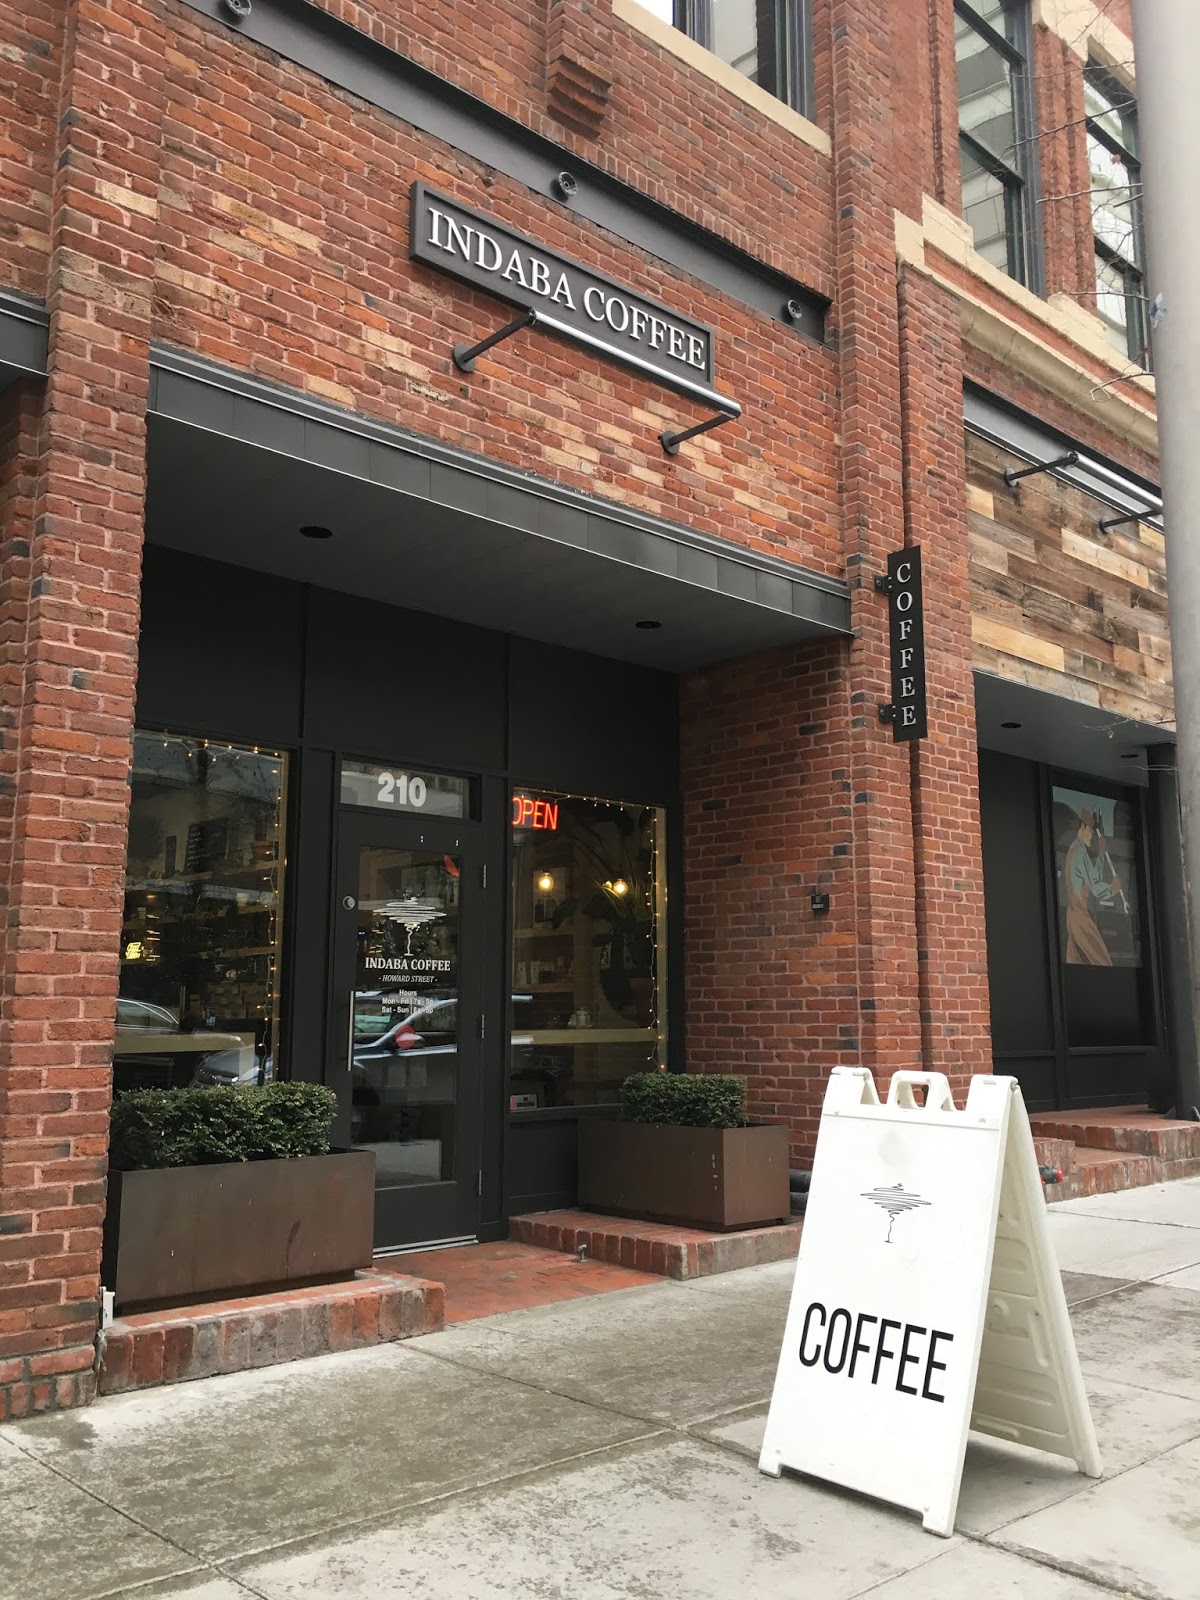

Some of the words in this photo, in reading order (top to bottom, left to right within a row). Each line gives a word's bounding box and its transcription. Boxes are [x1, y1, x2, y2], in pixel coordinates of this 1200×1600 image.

[428, 207, 577, 311] INDABA
[583, 286, 706, 371] COFFEE
[896, 563, 917, 727] COFFEE
[377, 772, 427, 807] 210
[365, 957, 408, 970] INDABA
[410, 959, 451, 971] COFFEE
[382, 974, 411, 982] HOWARD
[411, 975, 435, 983] STREET
[799, 1302, 954, 1403] COFFEE
